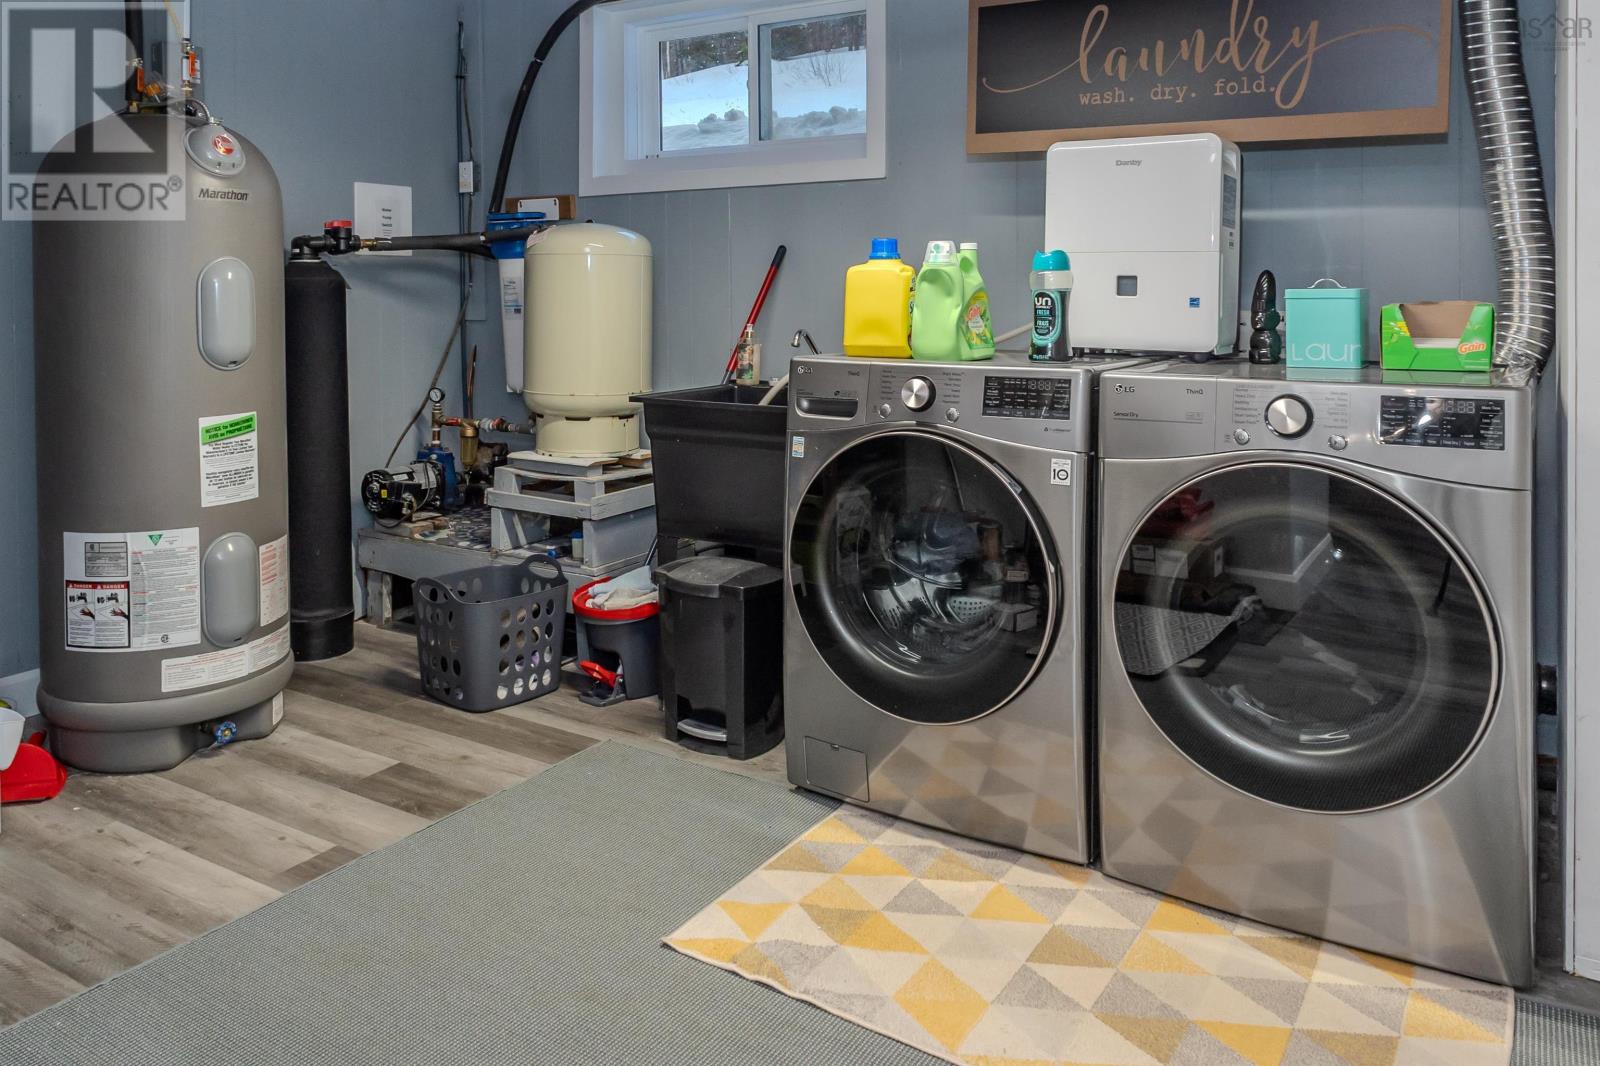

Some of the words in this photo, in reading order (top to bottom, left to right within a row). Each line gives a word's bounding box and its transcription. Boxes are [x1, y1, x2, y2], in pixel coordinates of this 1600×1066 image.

[1078, 87, 1135, 106] wash.
[1150, 83, 1197, 104] dry.
[1213, 76, 1276, 97] fold.
[1115, 159, 1143, 167] Danby
[198, 188, 249, 201] Marathon
[1458, 342, 1487, 354] Gain
[1053, 468, 1069, 481] 10
